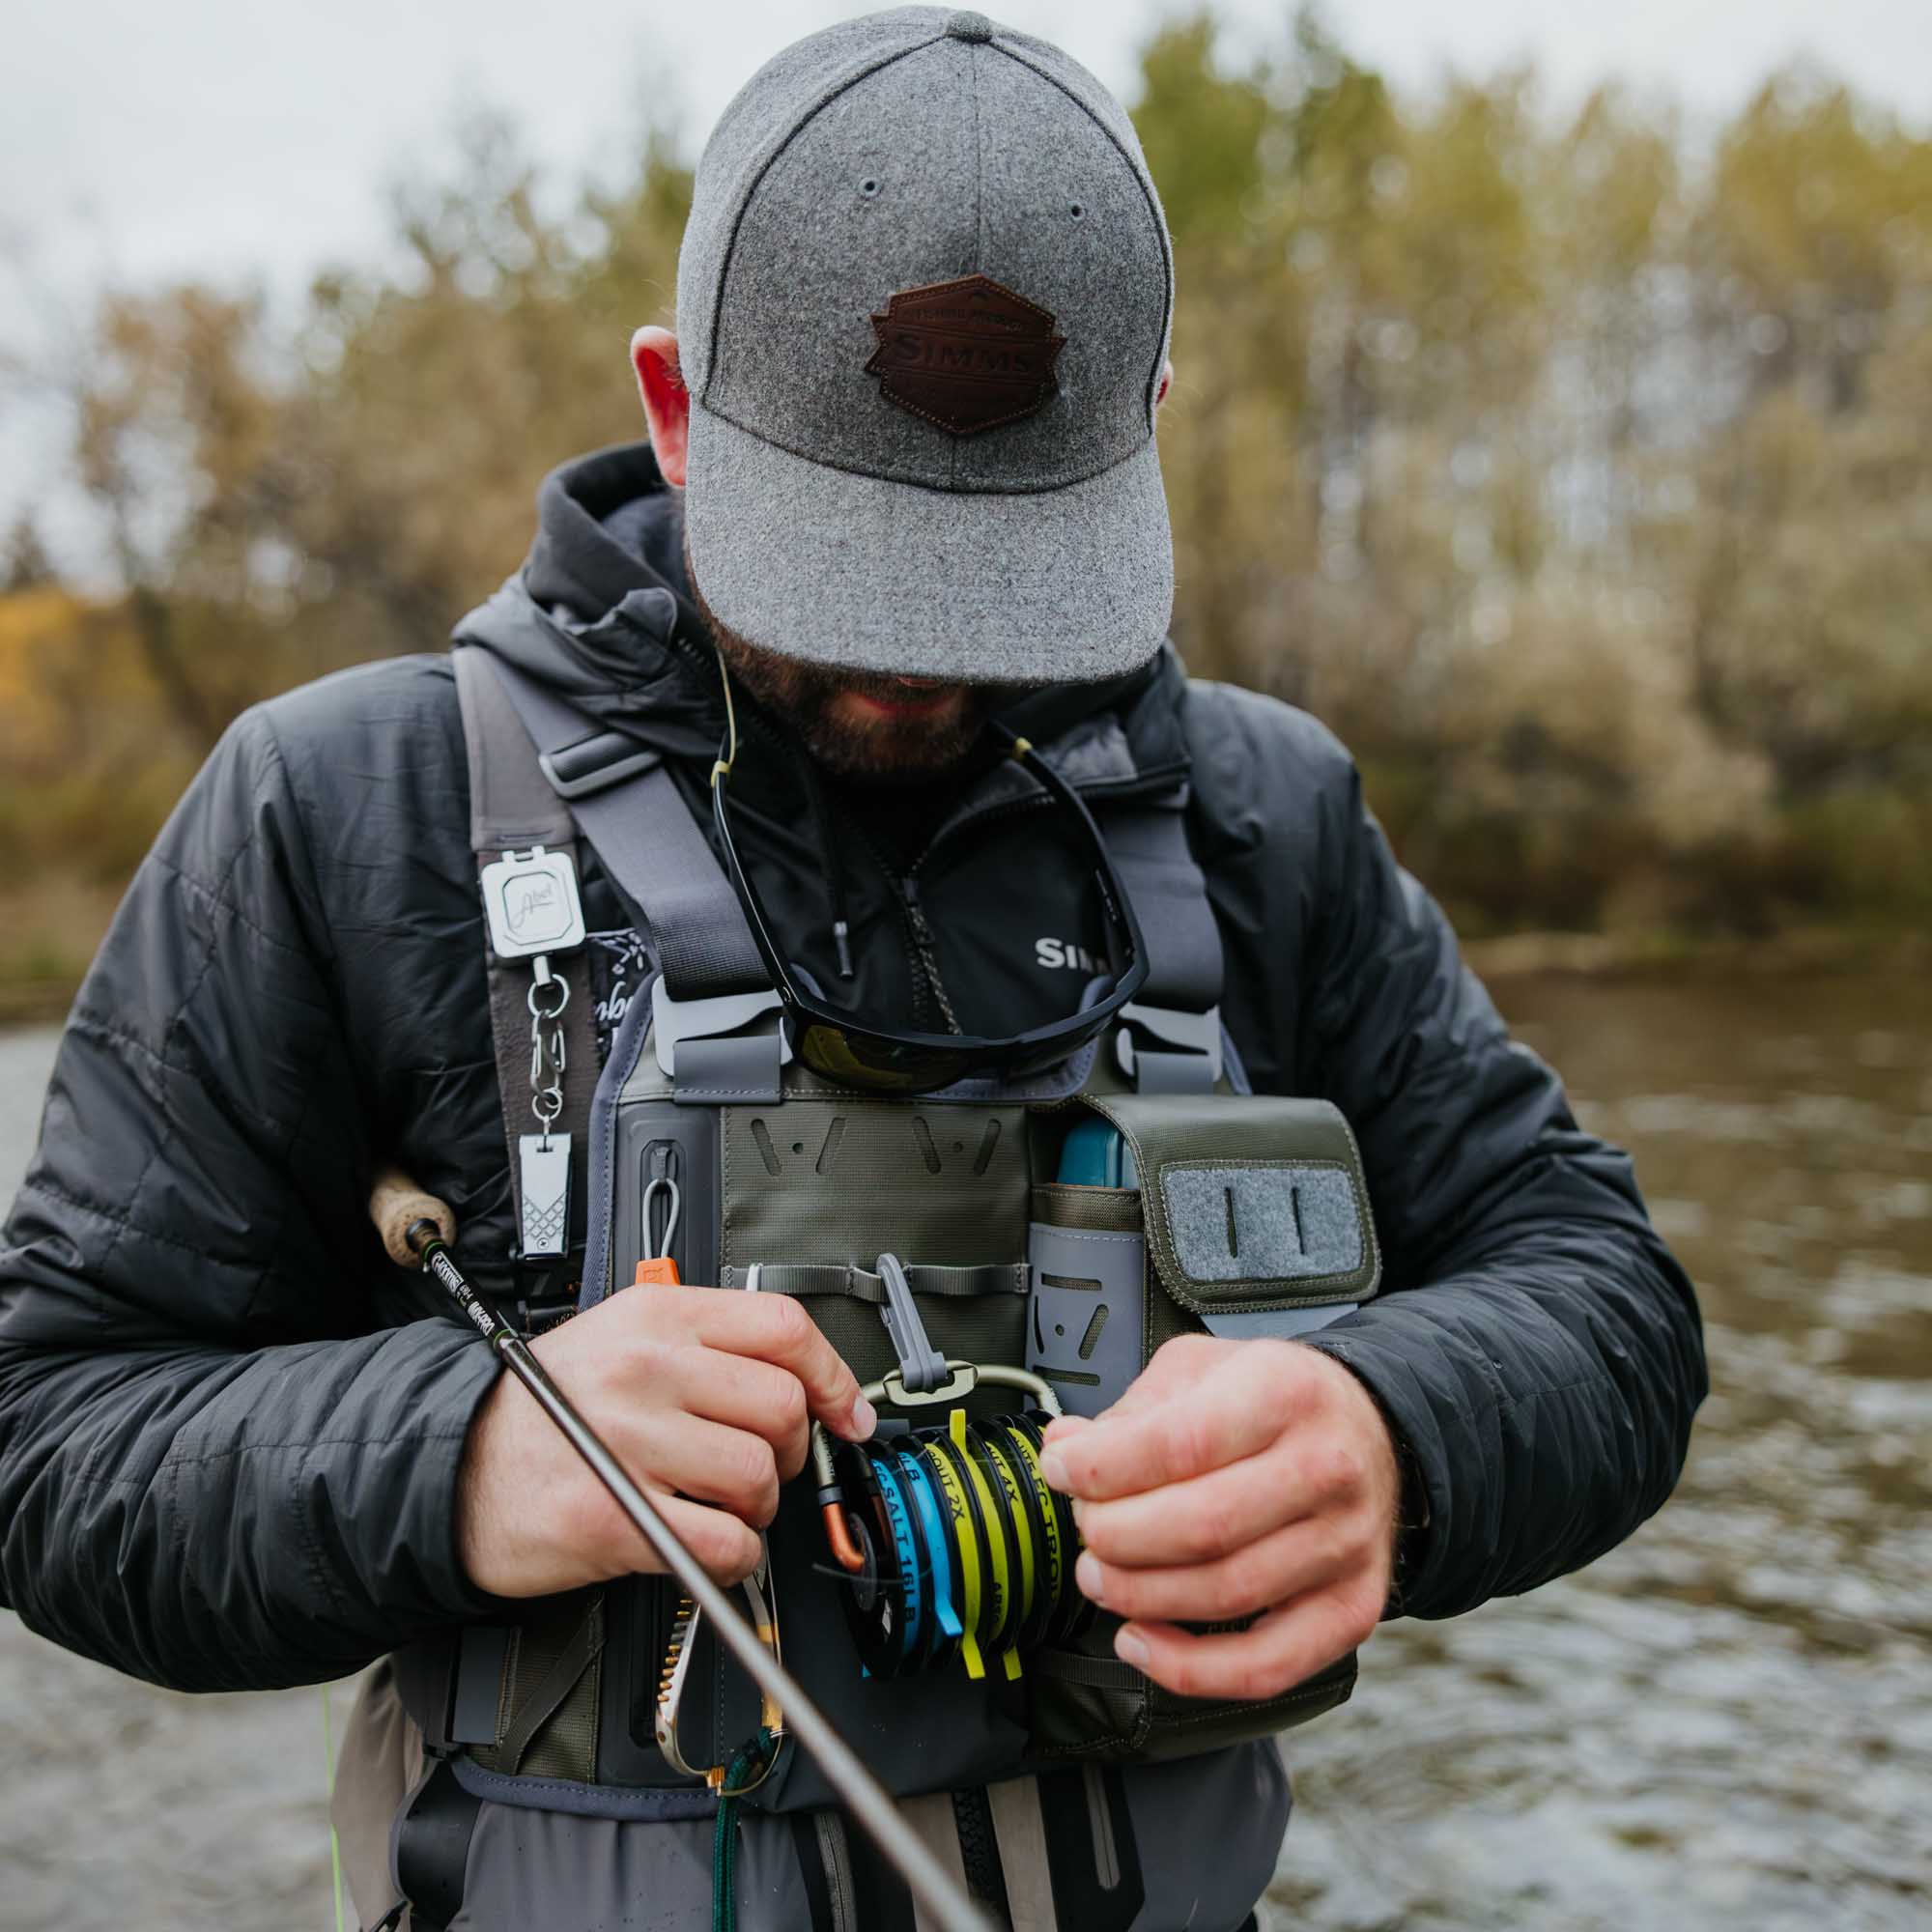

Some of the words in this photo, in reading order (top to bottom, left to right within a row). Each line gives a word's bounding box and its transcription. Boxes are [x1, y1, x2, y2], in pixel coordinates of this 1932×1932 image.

[948, 1494, 965, 1521] 2X
[883, 1488, 911, 1547] SALT
[900, 1554, 917, 1624] 16LB
